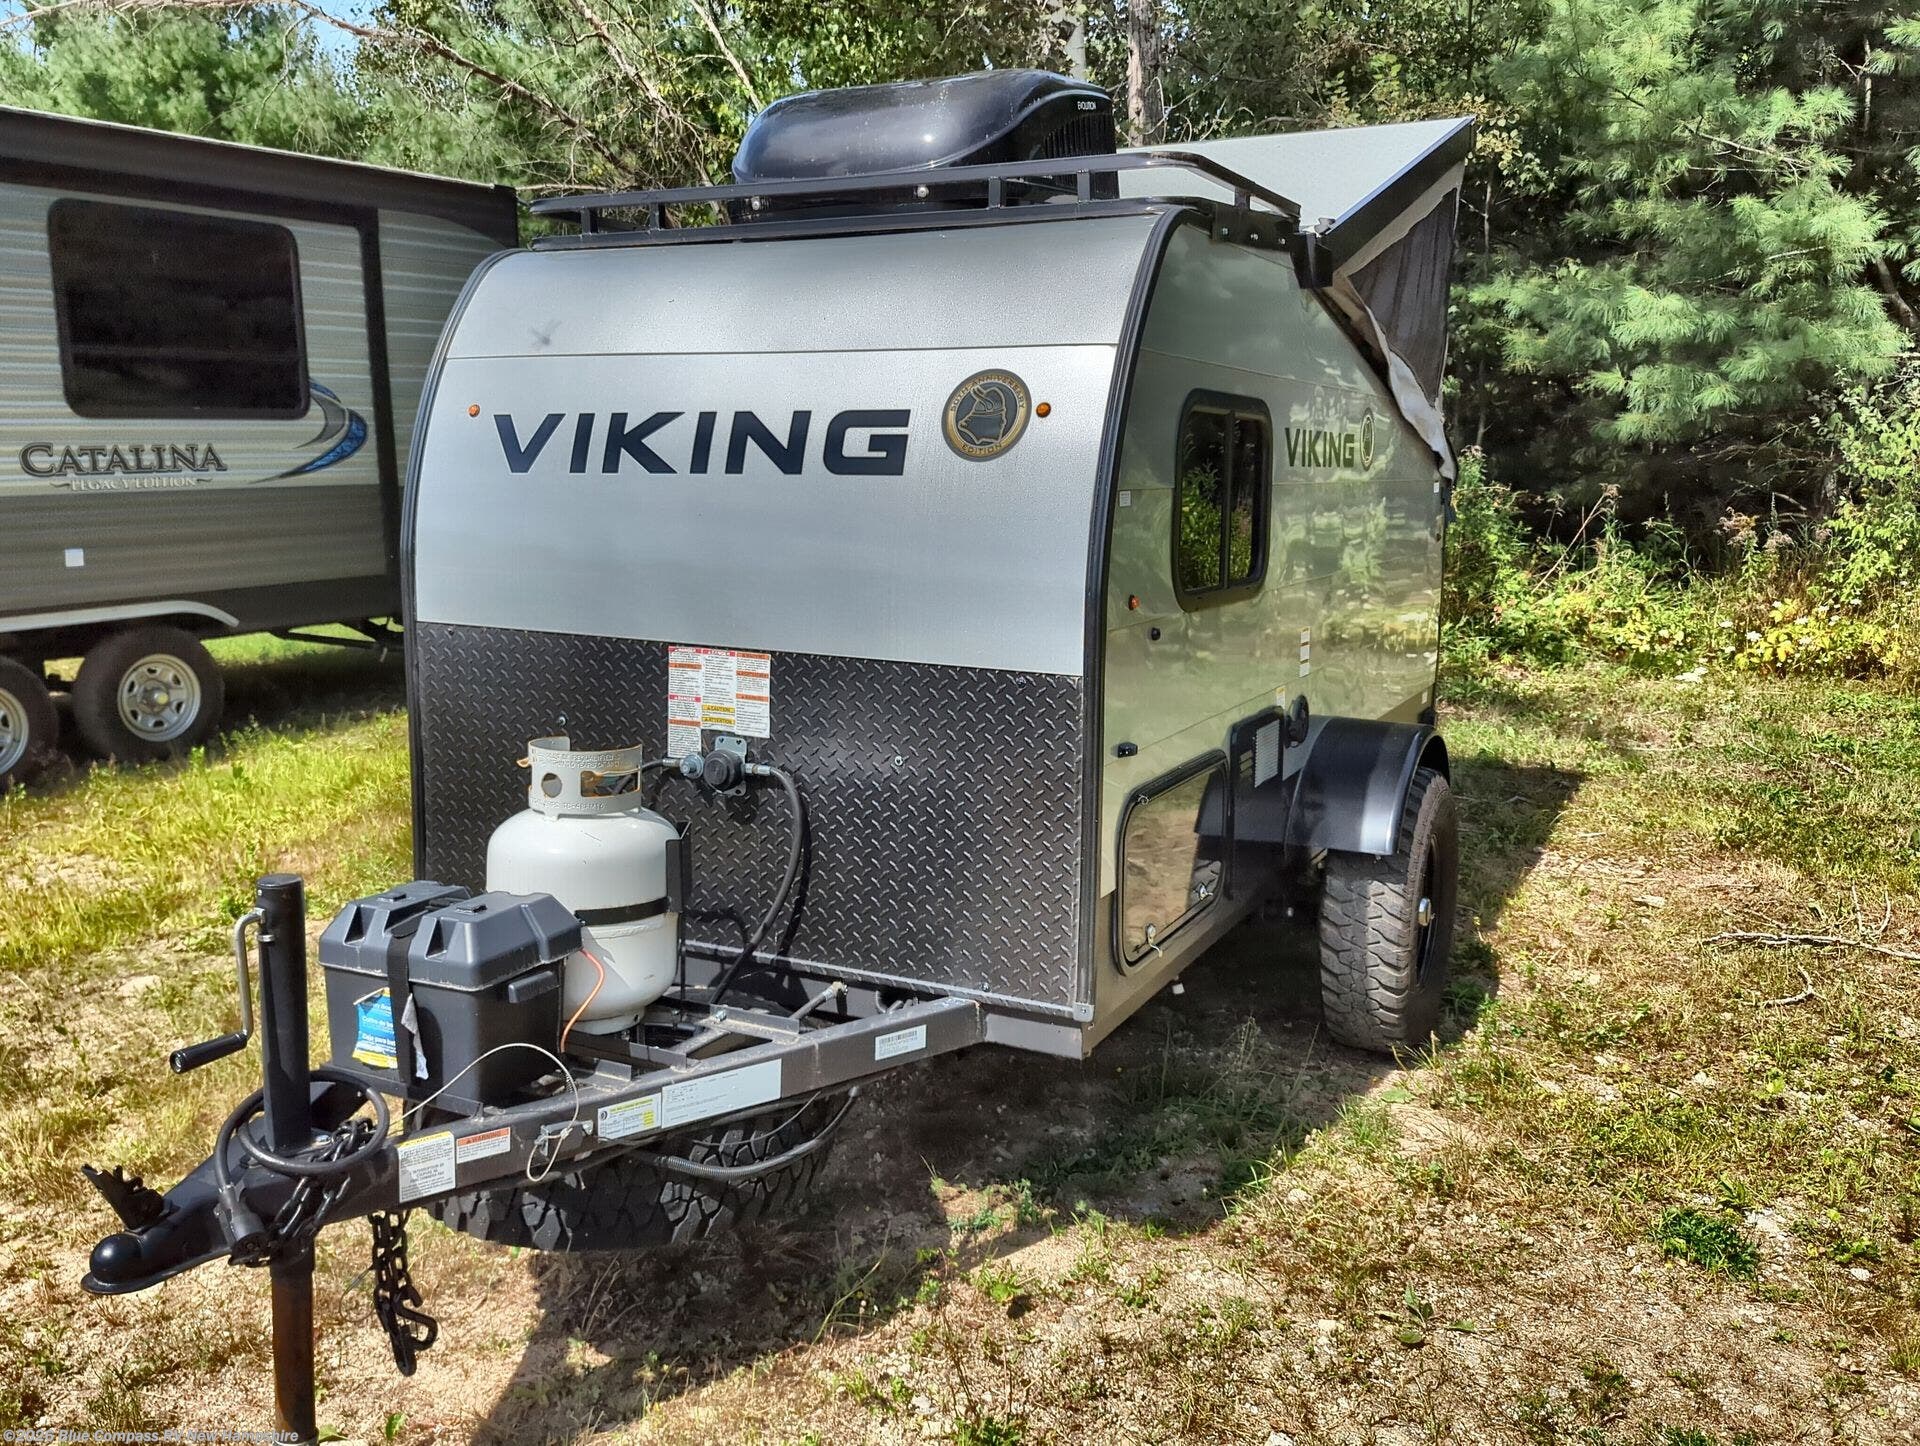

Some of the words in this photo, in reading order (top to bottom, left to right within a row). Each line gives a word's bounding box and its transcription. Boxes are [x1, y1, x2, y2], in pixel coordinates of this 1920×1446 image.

[493, 409, 912, 476] VIKING
[961, 443, 1003, 455] EDITION
[1284, 427, 1355, 468] VIKING
[18, 441, 228, 477] CATALINA
[71, 478, 131, 491] LEGACY
[134, 476, 196, 489] EDITION
[709, 704, 731, 713] CAUTION
[472, 1130, 502, 1143] WARNING
